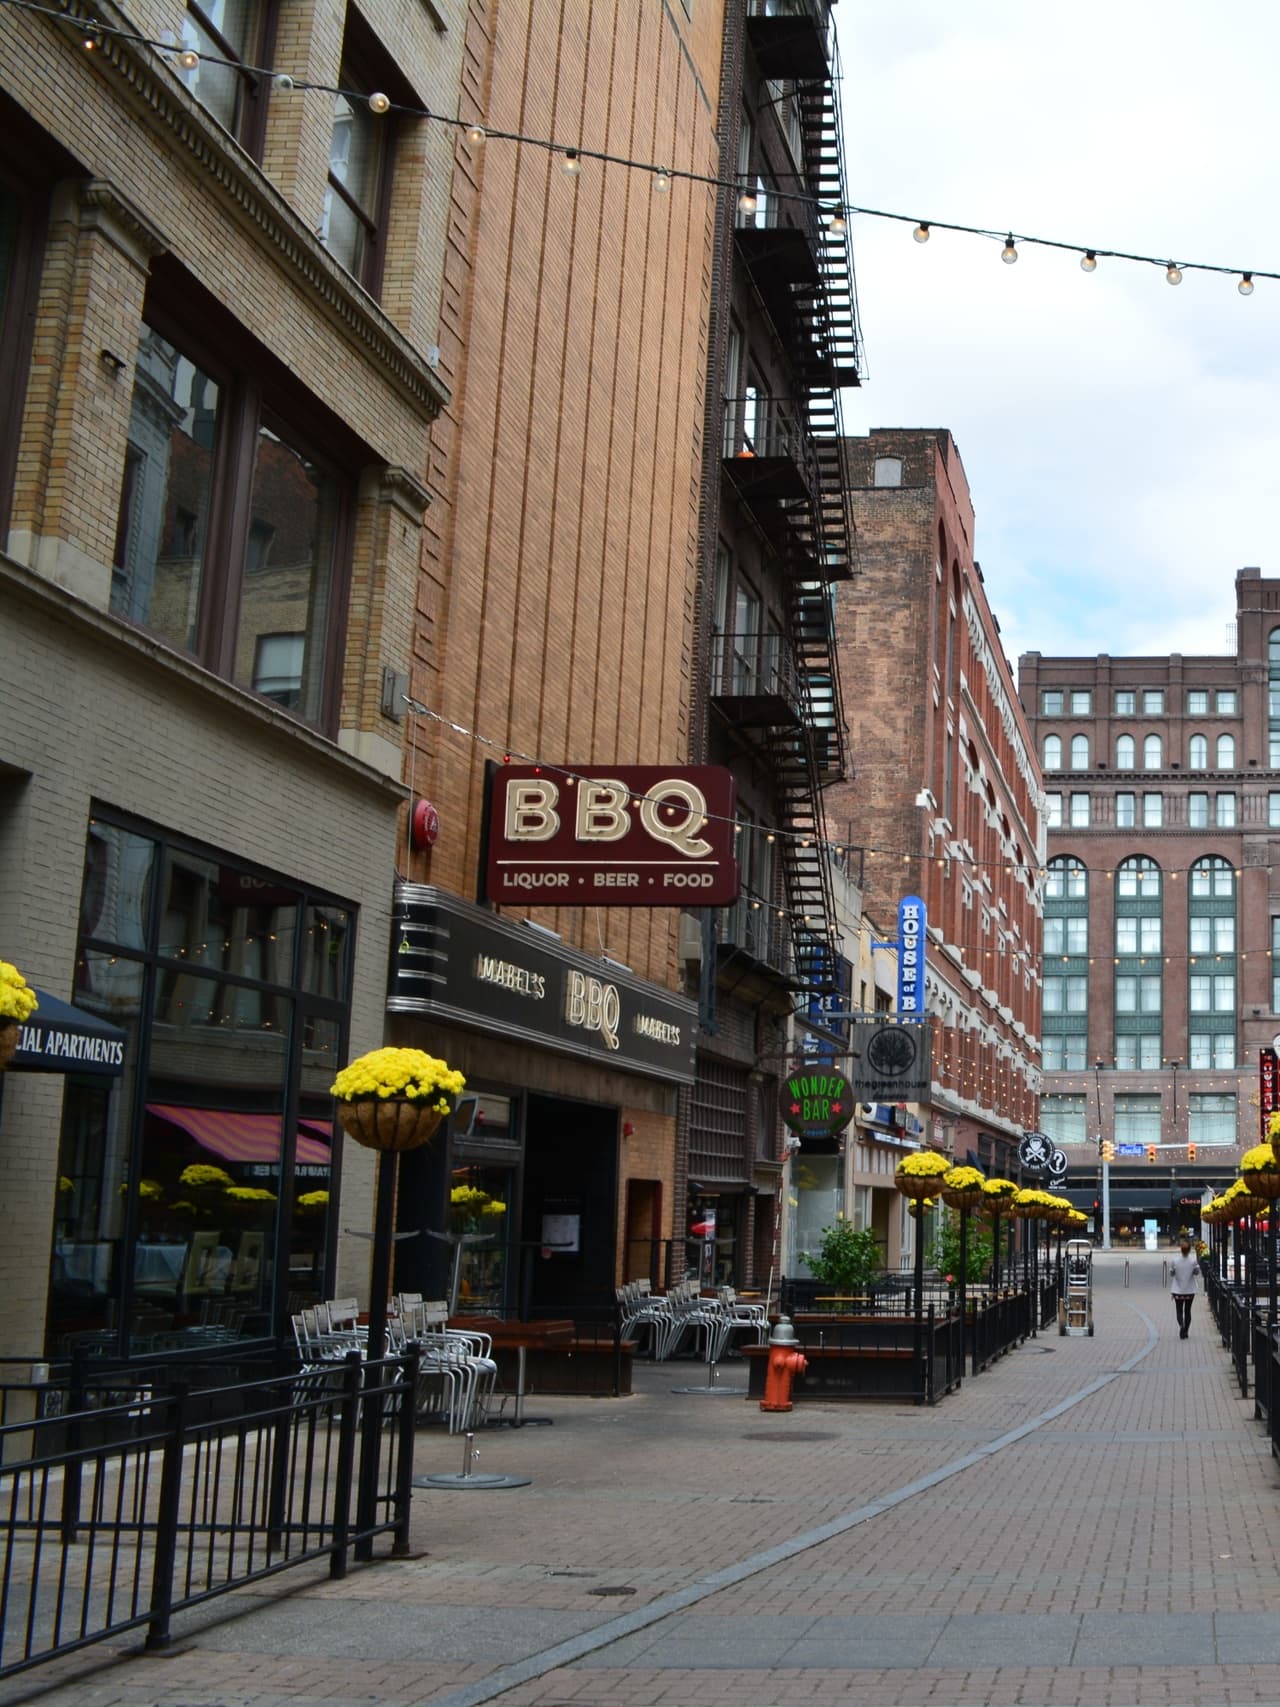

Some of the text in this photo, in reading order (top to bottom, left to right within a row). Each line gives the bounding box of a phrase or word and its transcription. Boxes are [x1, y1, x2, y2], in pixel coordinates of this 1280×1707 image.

[504, 778, 713, 858] BBQ
[503, 873, 714, 889] LIQUOR BEER FOOD
[902, 904, 919, 982] HOUSE
[477, 954, 545, 999] MABEL'S
[903, 984, 915, 993] of
[567, 970, 620, 1049] BBQ
[636, 1014, 681, 1046] MABEL'S
[45, 1030, 124, 1065] APARTMENTS
[788, 1074, 845, 1100] WONDER
[803, 1099, 830, 1121] BAR
